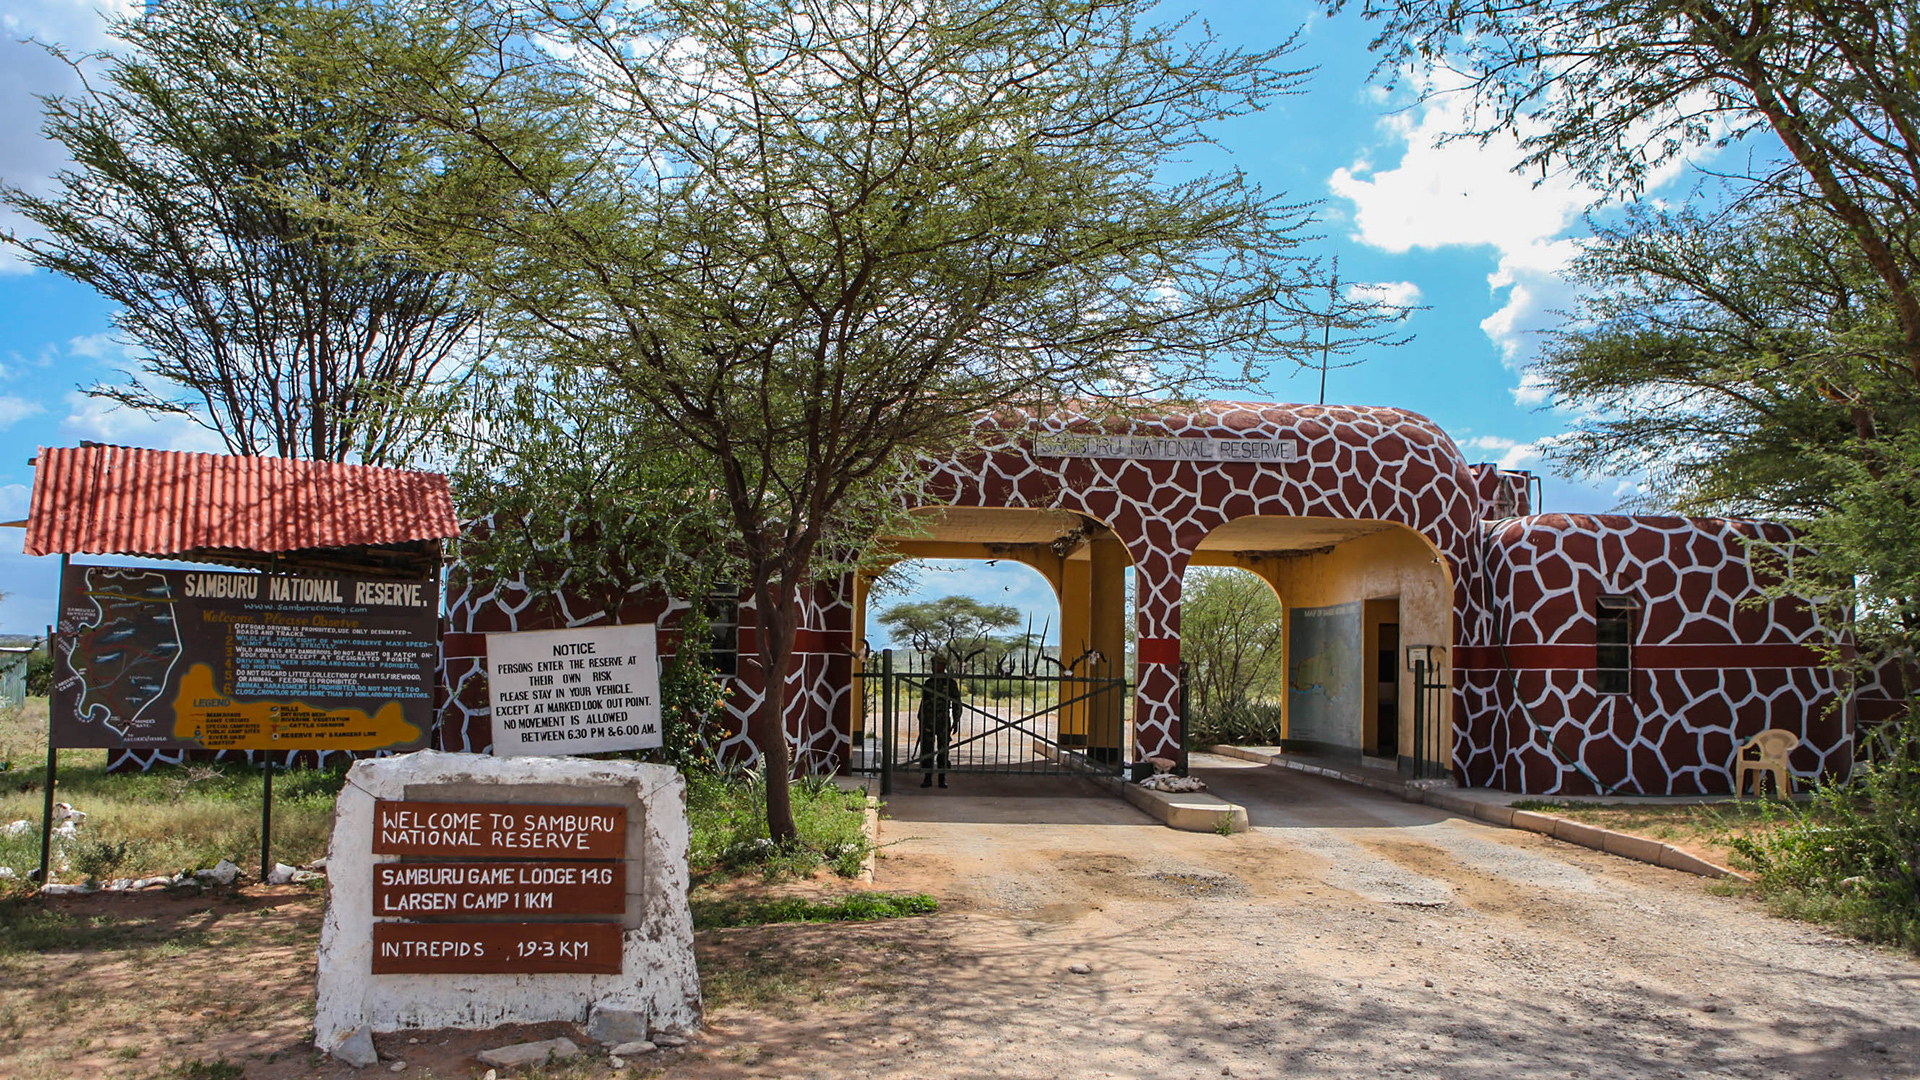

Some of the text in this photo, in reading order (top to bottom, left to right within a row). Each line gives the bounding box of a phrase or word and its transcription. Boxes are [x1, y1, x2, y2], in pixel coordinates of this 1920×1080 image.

[1131, 439, 1212, 458] NATIONAL
[1220, 441, 1290, 459] RESERVE
[185, 573, 428, 607] SAMBURU NATIONAL RESERVE.
[265, 612, 309, 625] Please
[553, 643, 596, 656] NOTICE
[498, 656, 637, 674] PERSONS ENTER THE RESERVE AT
[529, 671, 612, 686] THEIR OWN RISK
[193, 698, 231, 707] LEGEND
[500, 691, 529, 701] PLEASE
[532, 689, 552, 700] STAY
[556, 689, 564, 698] IN
[569, 687, 591, 697] YOUR
[496, 696, 651, 716] EXCEPT AT MARKED LOOK OUT POINT.
[504, 712, 628, 729] NO MOVEMENT IS ALLOWED
[522, 729, 565, 742] BETWEEN
[568, 729, 587, 739] 6.30
[591, 727, 605, 738] PM
[641, 723, 657, 735] AM.
[382, 811, 615, 833] WELCOME TO SAMBURU
[382, 829, 590, 850] NATIONAL RESERVE
[382, 868, 464, 886] SAMBURU
[468, 868, 515, 885] GAME
[520, 868, 577, 885] LODGE
[384, 893, 456, 911] LARSEN
[463, 892, 509, 909] CAMP
[381, 942, 484, 957] INTREPIDS
[560, 941, 589, 960] KM
